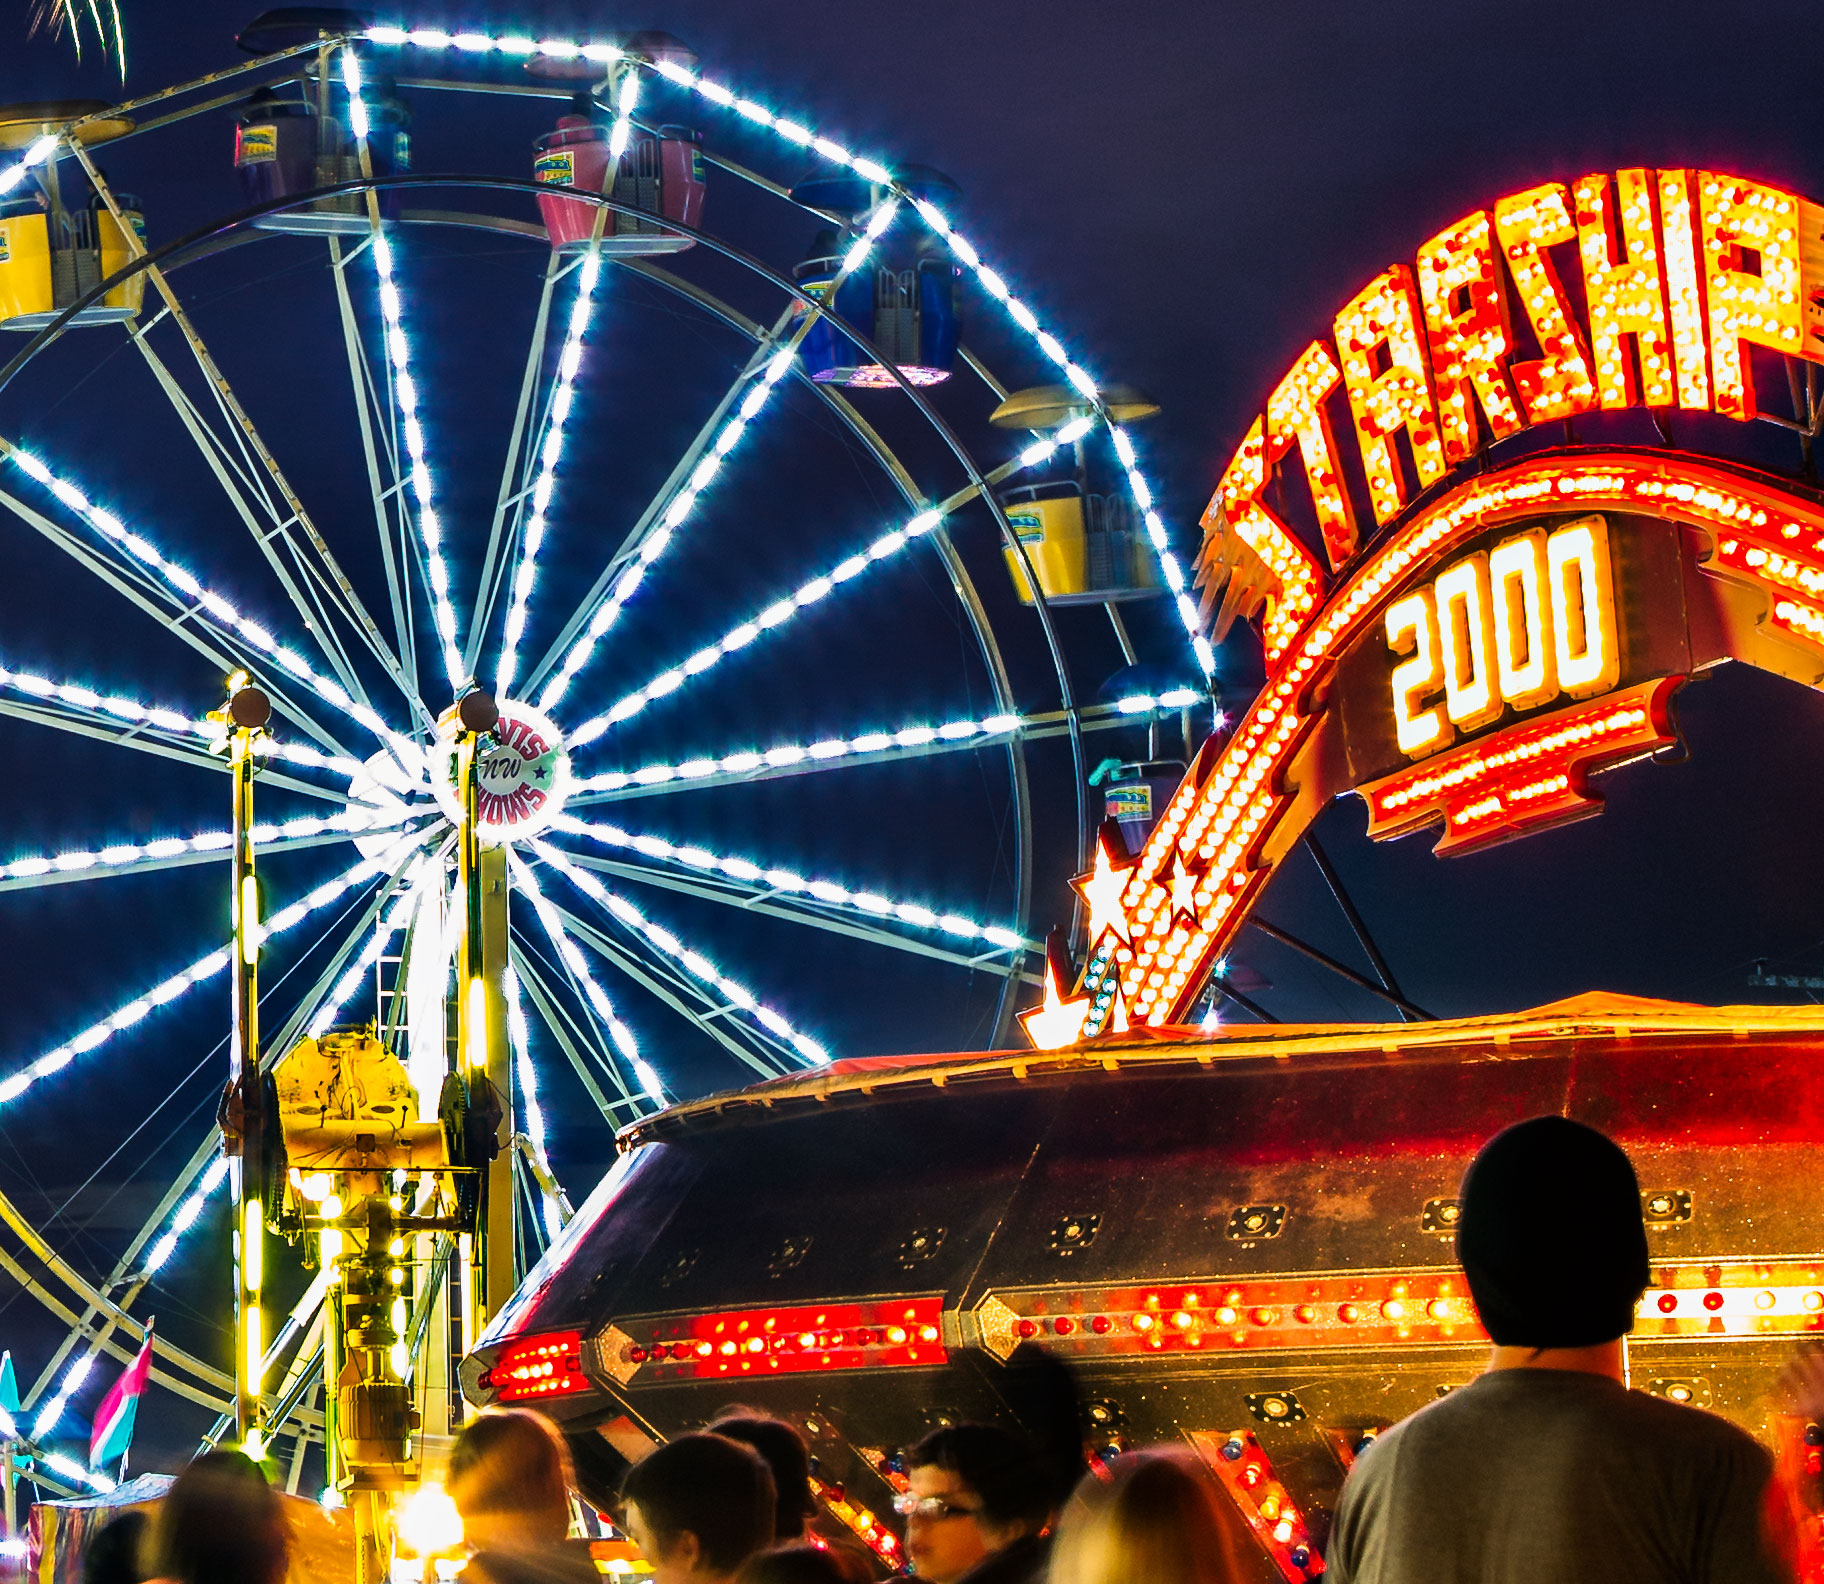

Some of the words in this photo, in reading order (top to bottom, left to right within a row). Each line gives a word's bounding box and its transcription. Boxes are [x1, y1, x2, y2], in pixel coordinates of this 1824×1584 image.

[1224, 167, 1804, 679] STARSHIP
[1385, 515, 1619, 758] 2000
[478, 781, 547, 825] HOWS
[497, 717, 550, 761] VIS
